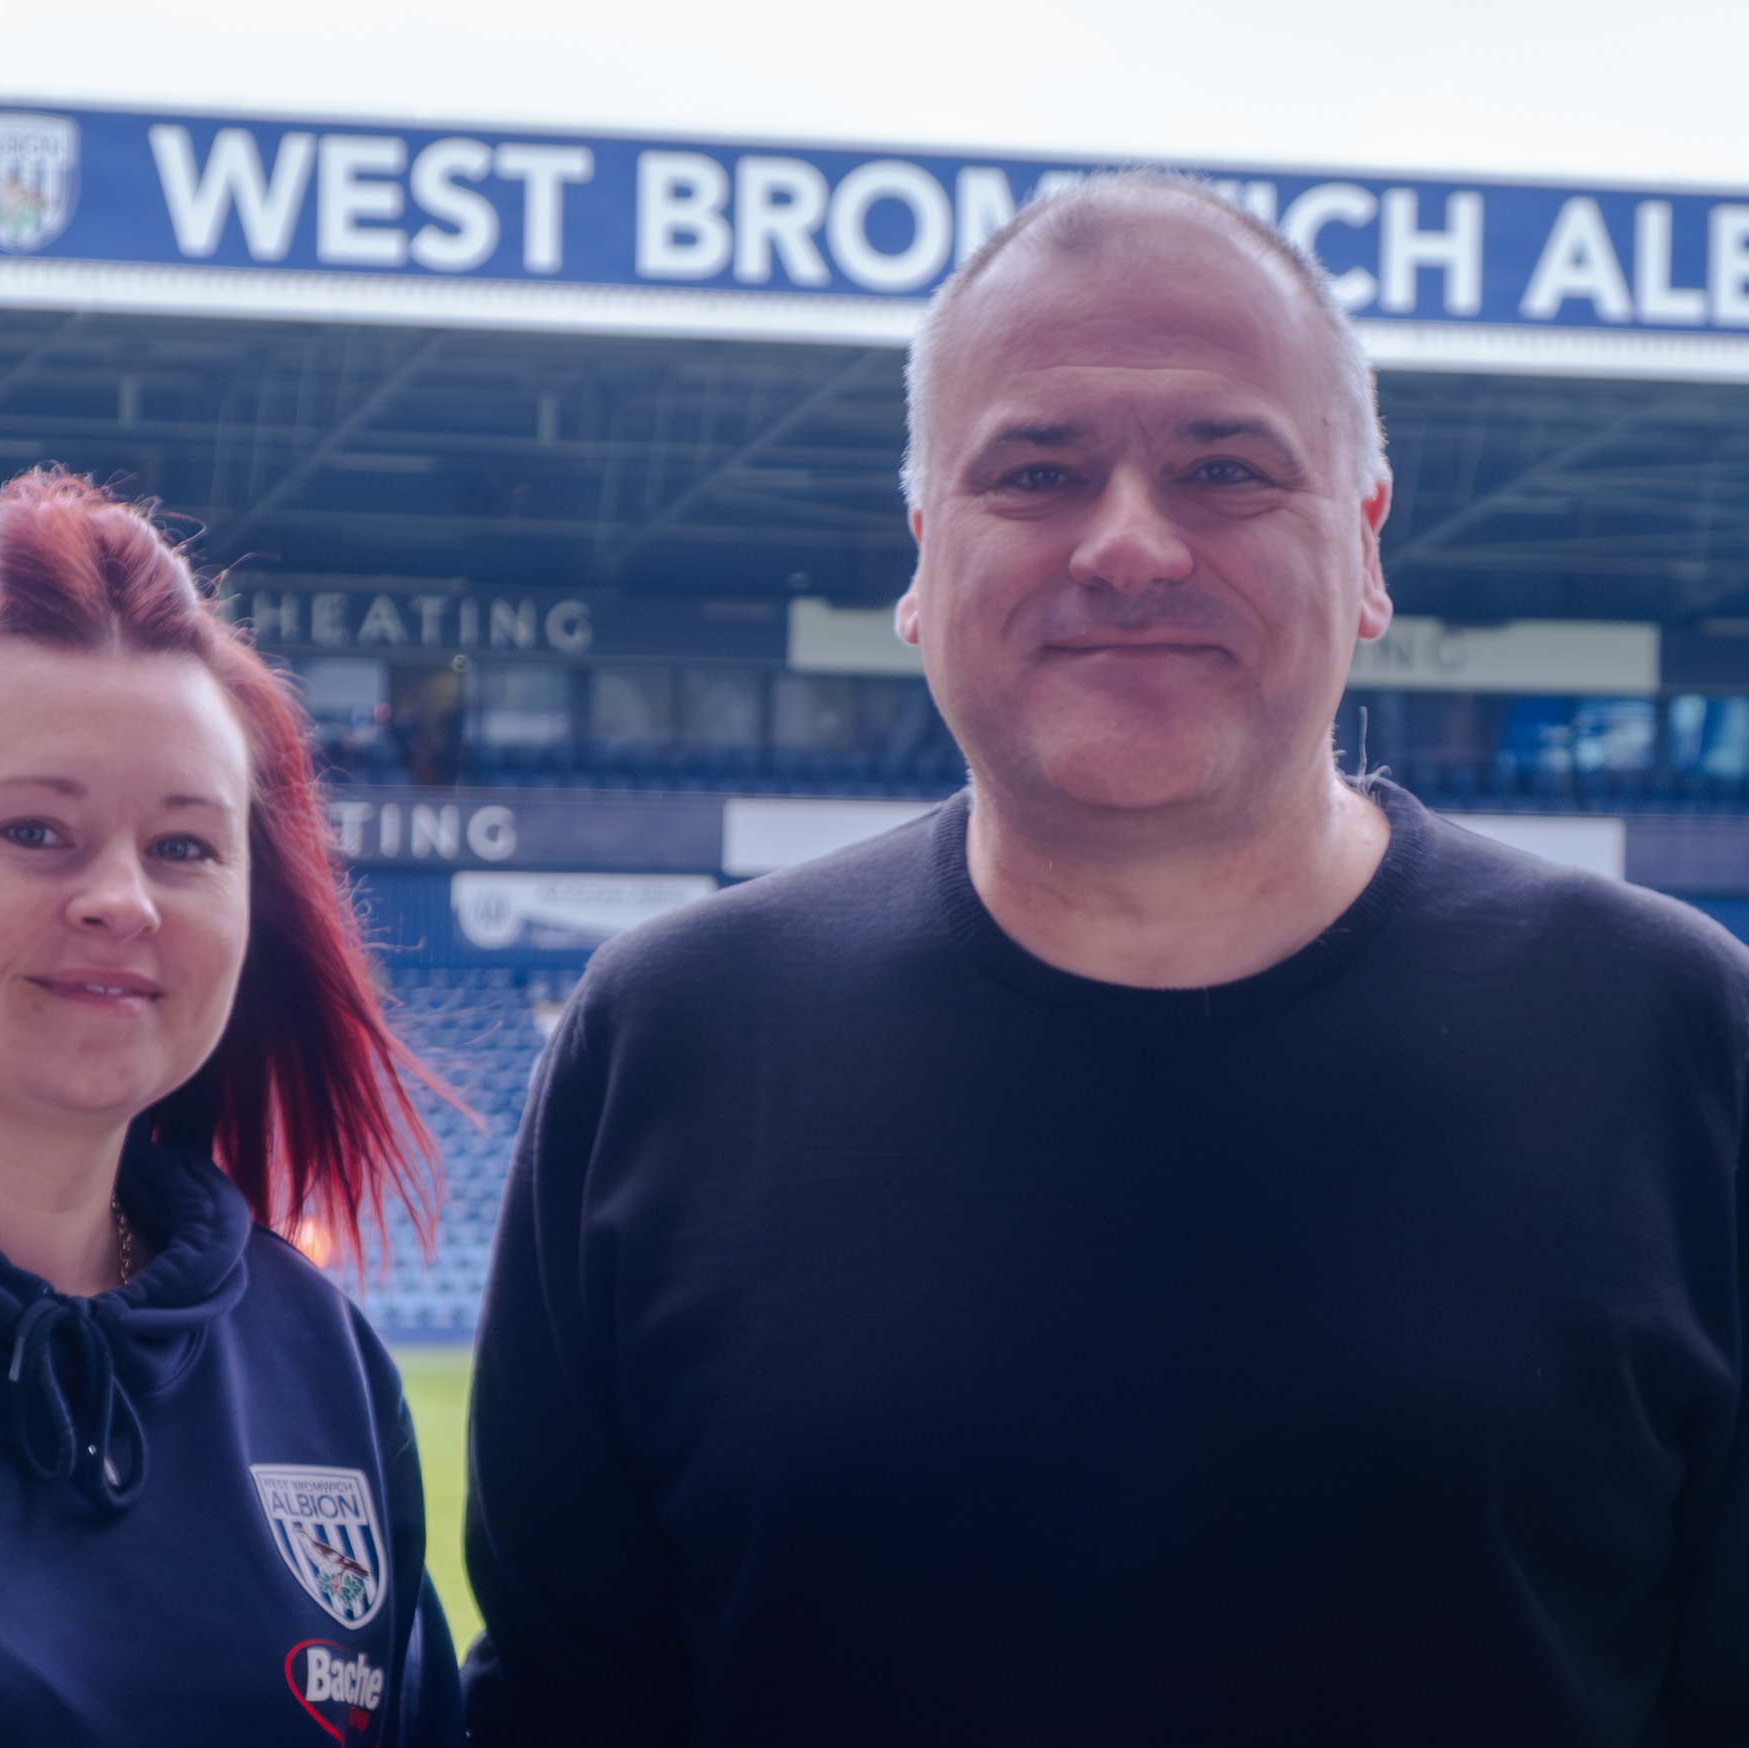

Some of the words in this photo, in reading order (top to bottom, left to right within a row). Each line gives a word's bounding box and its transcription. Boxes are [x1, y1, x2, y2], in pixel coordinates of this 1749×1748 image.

[149, 121, 597, 275] WEST
[272, 1491, 360, 1519] ALBION
[305, 1647, 384, 1710] Bache
